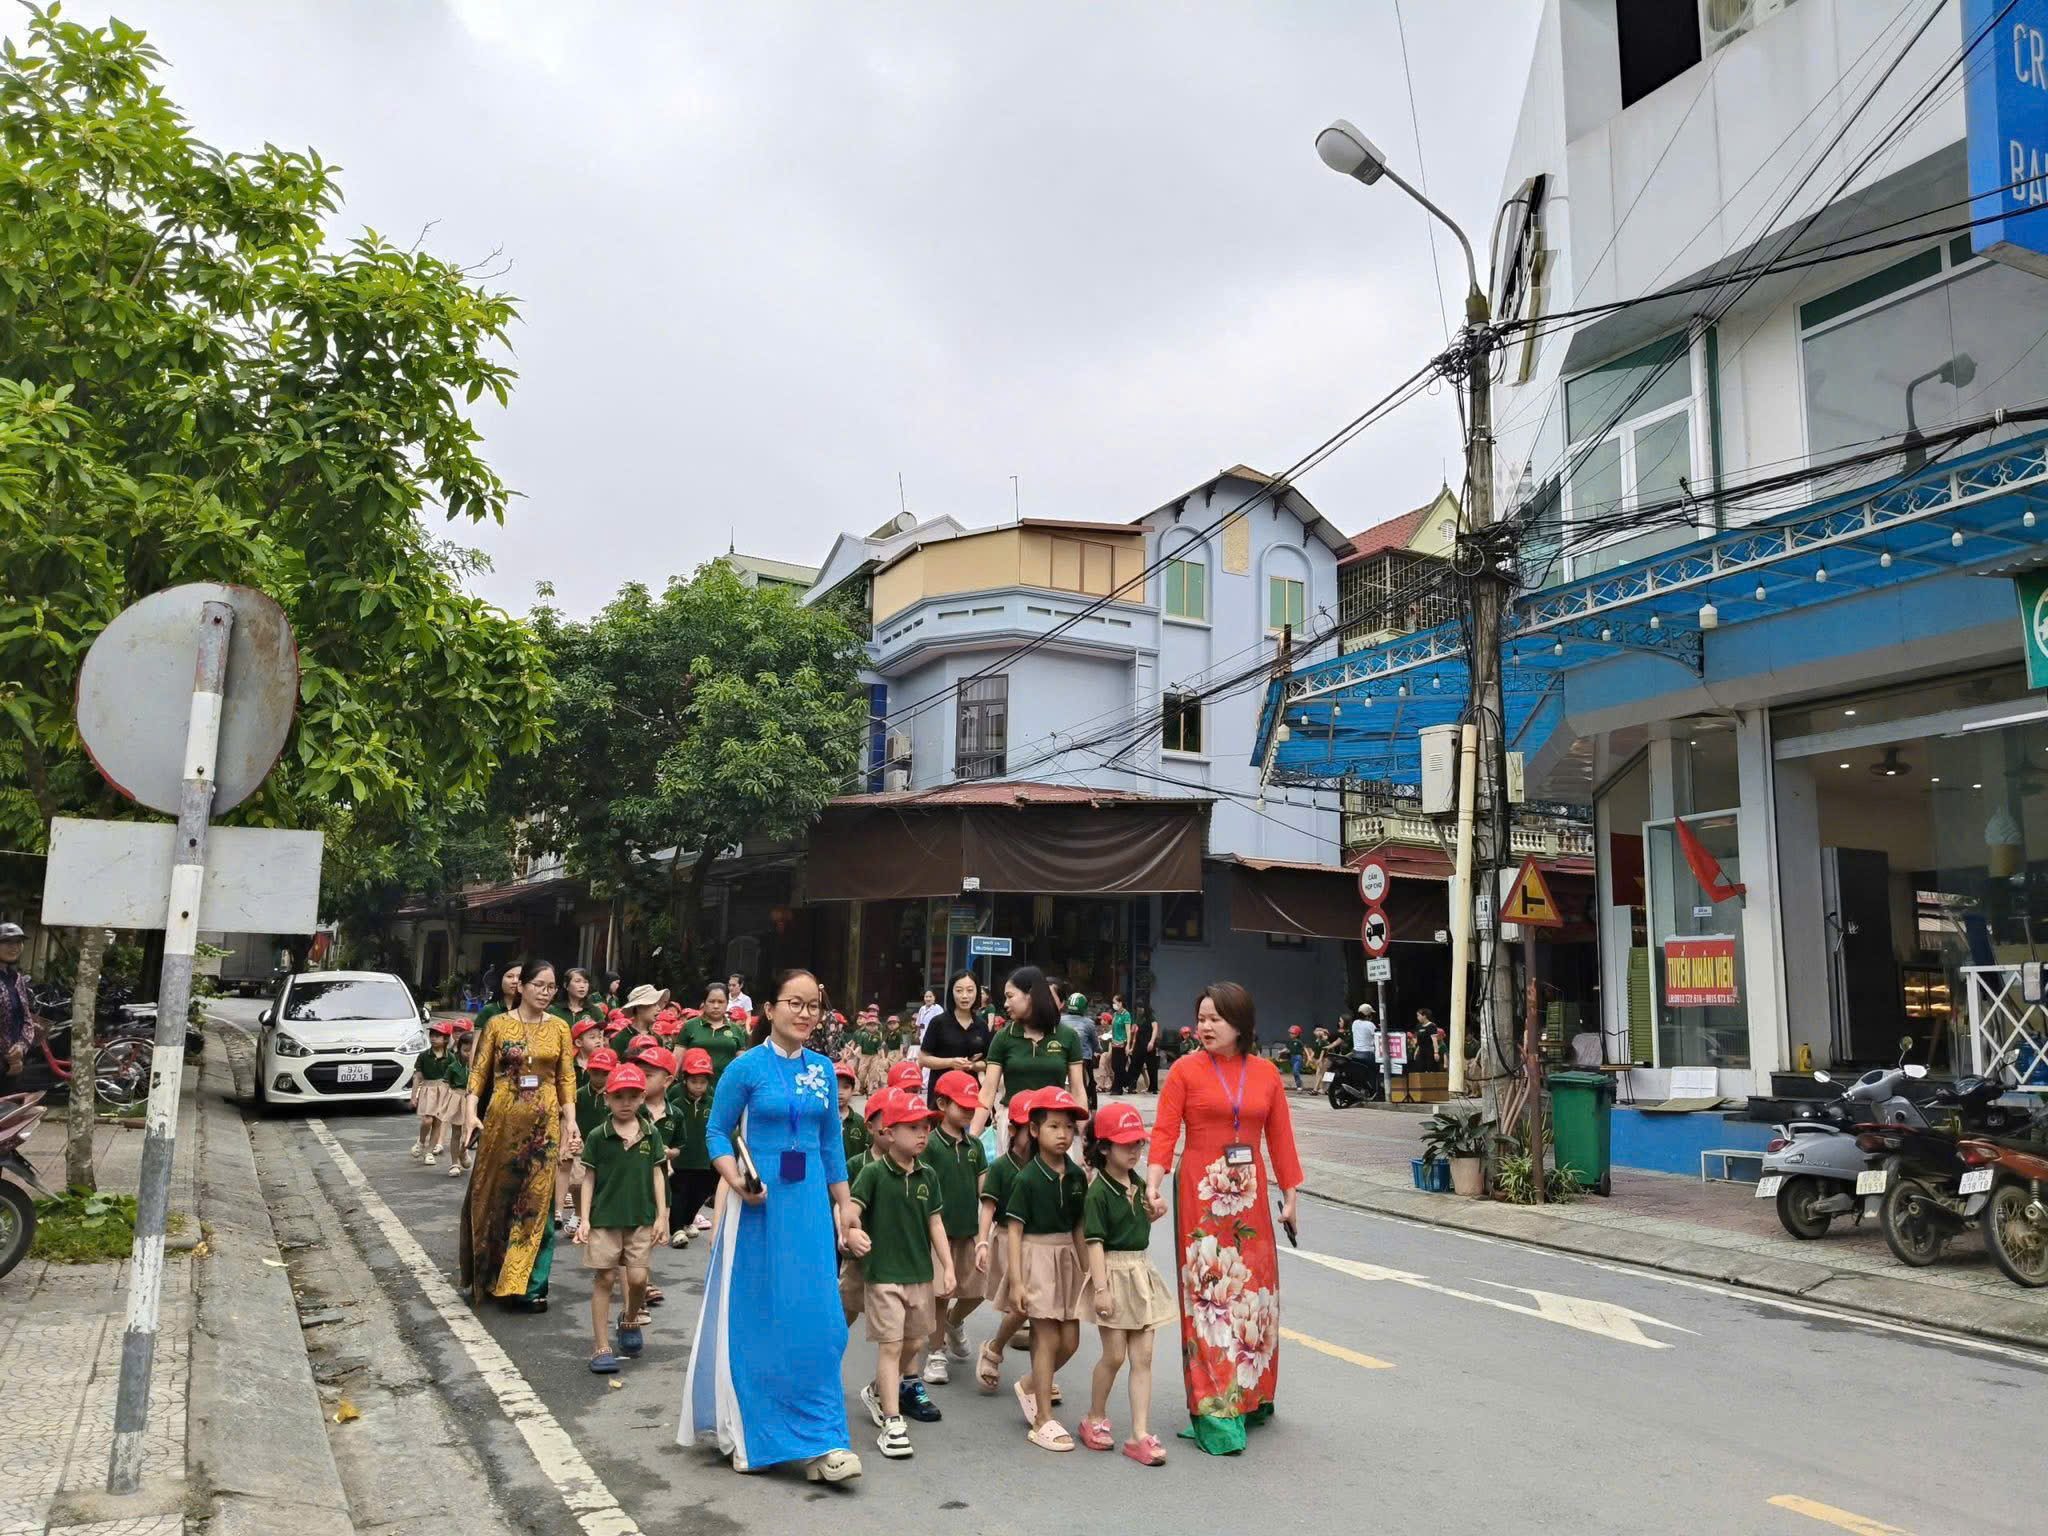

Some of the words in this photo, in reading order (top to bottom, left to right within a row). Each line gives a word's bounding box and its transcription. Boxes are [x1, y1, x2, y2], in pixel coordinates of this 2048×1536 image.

[1667, 944, 1691, 989] TUYỂN
[1692, 949, 1714, 989] NHÂN
[1715, 949, 1734, 988] VIÊN
